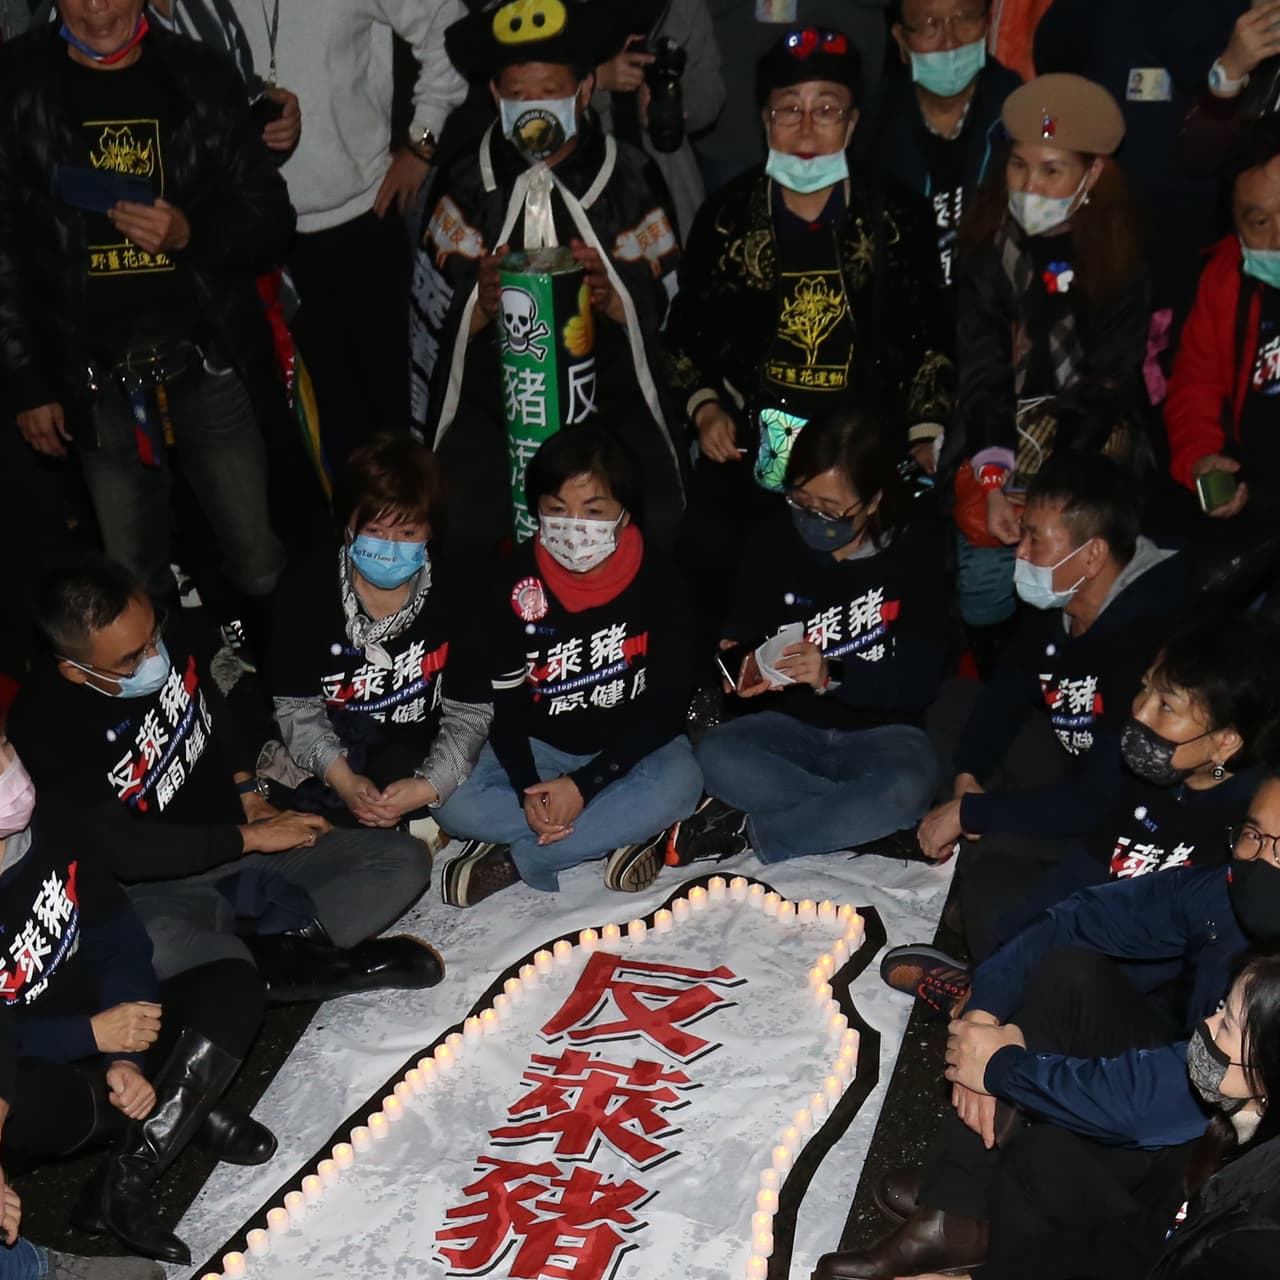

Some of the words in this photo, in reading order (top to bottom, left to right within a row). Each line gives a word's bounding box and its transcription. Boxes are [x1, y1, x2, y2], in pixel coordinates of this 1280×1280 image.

[565, 356, 599, 425] 反
[107, 665, 192, 798] 反萊豬
